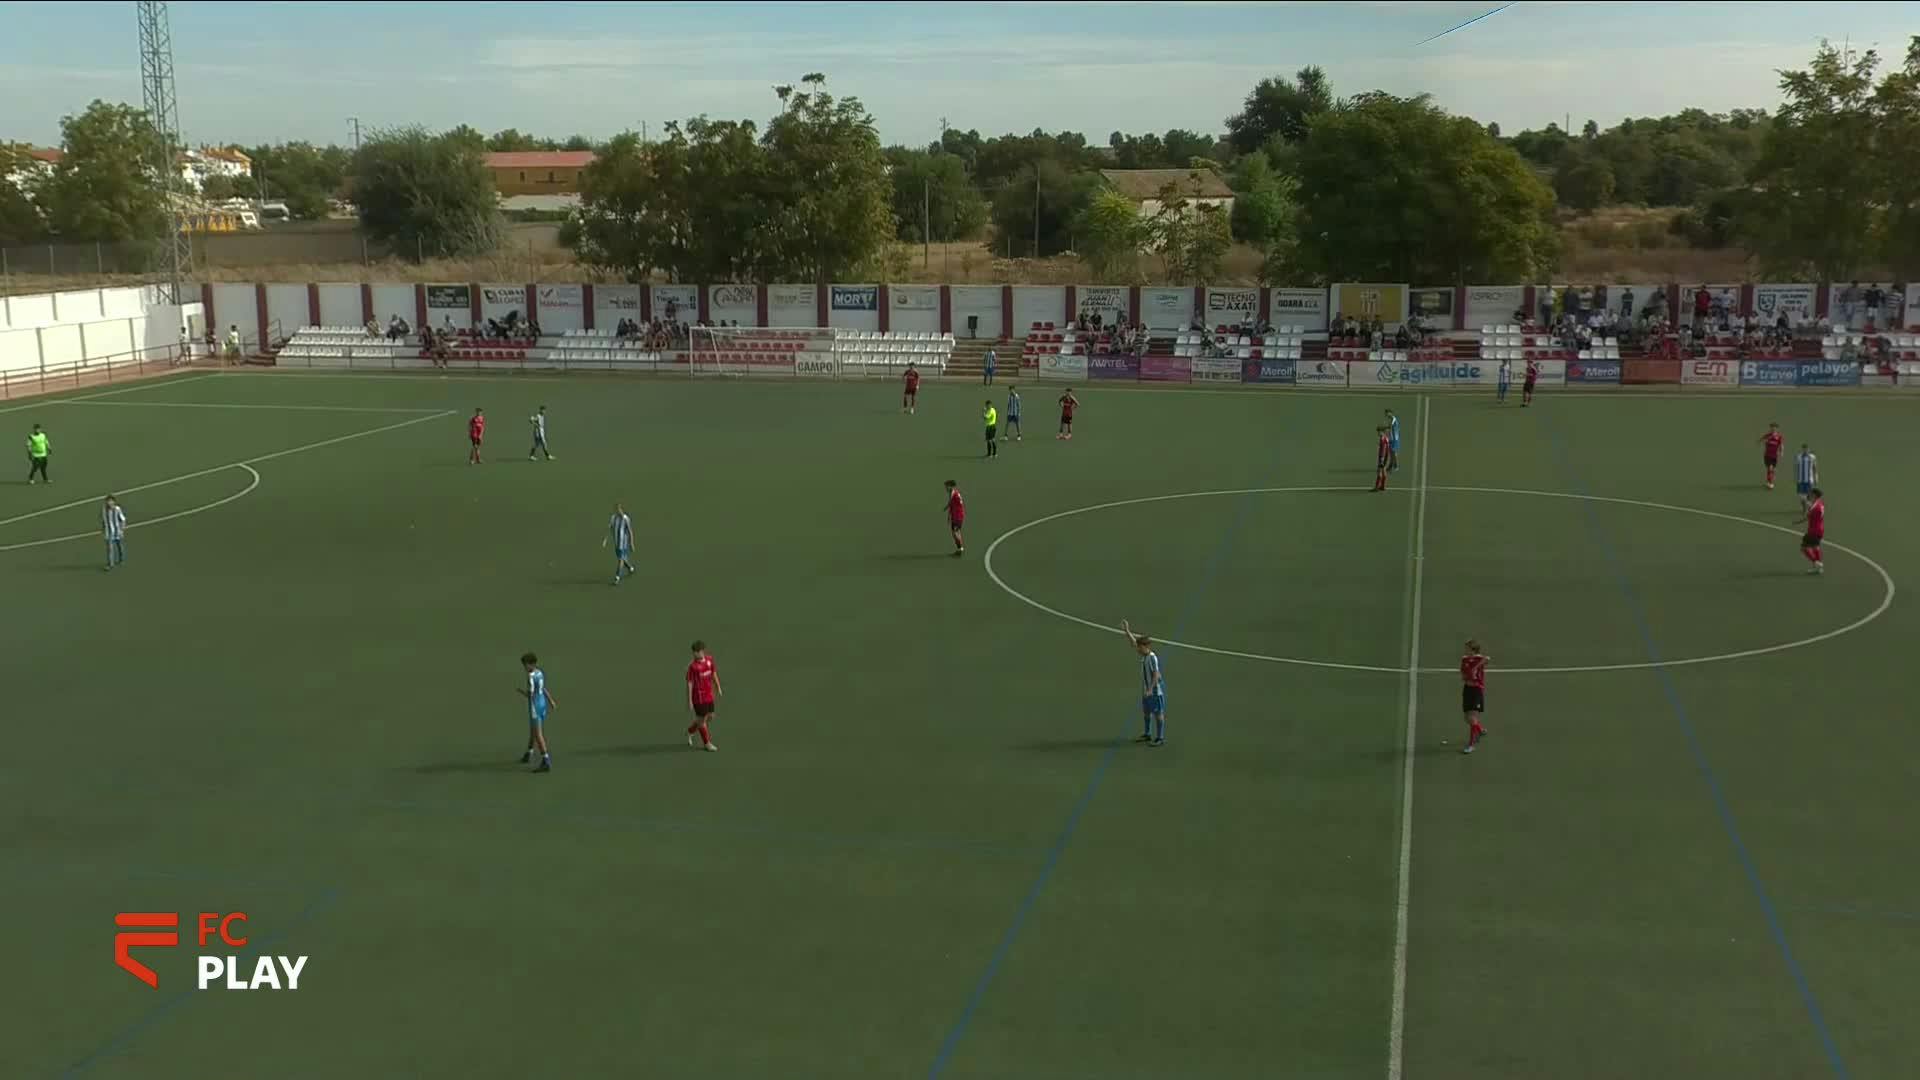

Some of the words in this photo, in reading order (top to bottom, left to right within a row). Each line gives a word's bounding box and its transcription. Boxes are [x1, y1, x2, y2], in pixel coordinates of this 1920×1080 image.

[1227, 293, 1257, 303] TECNO
[1226, 302, 1257, 311] AXATI
[798, 362, 833, 373] CAMPO
[1090, 359, 1129, 369] AVATEL
[1743, 361, 1758, 380] B
[1801, 362, 1849, 377] pelayo
